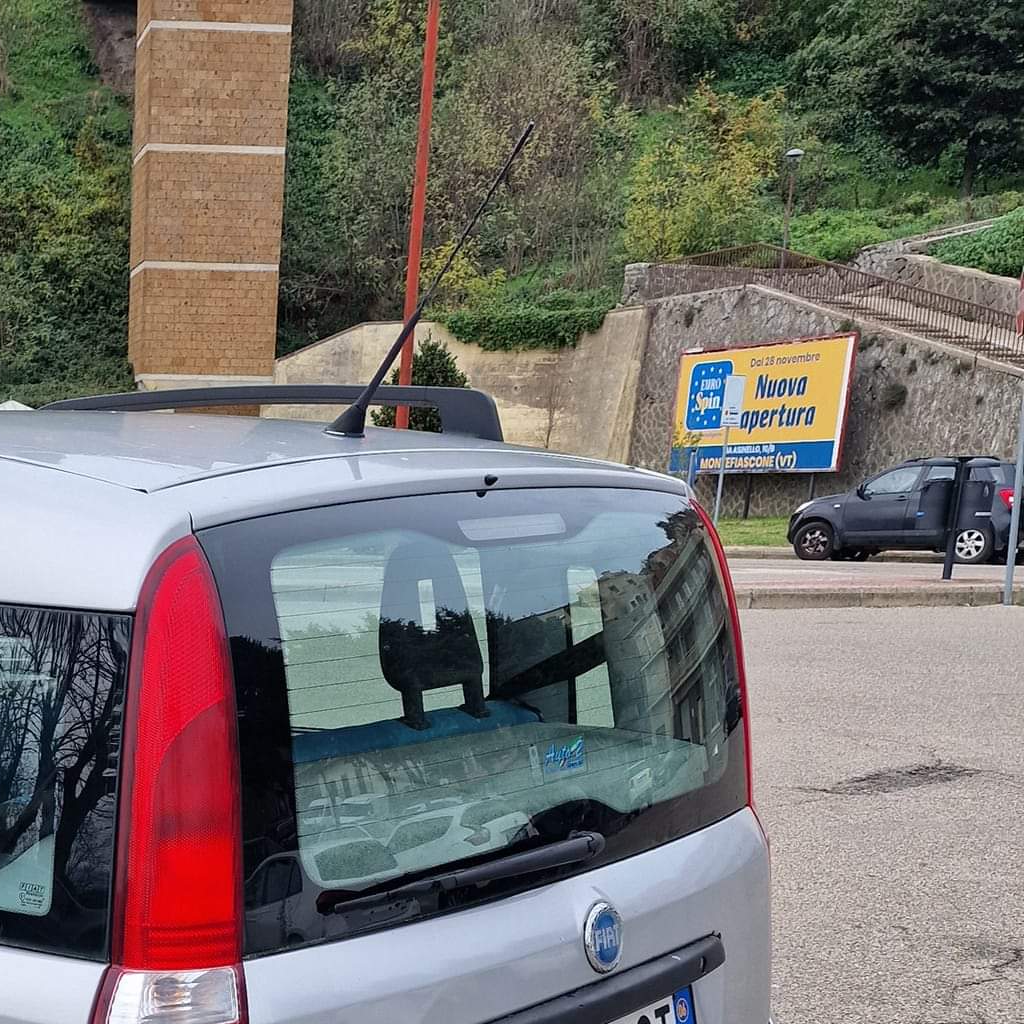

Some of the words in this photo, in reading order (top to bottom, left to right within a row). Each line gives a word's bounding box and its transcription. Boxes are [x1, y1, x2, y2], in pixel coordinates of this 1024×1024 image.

[751, 358, 764, 368] Dal
[776, 351, 821, 365] novembre
[700, 378, 722, 391] EURO
[755, 374, 808, 400] Nuova
[694, 391, 722, 415] Spin
[740, 403, 816, 434] apertura
[700, 455, 775, 469] MONEFIASCONE
[775, 451, 797, 469] (VT)
